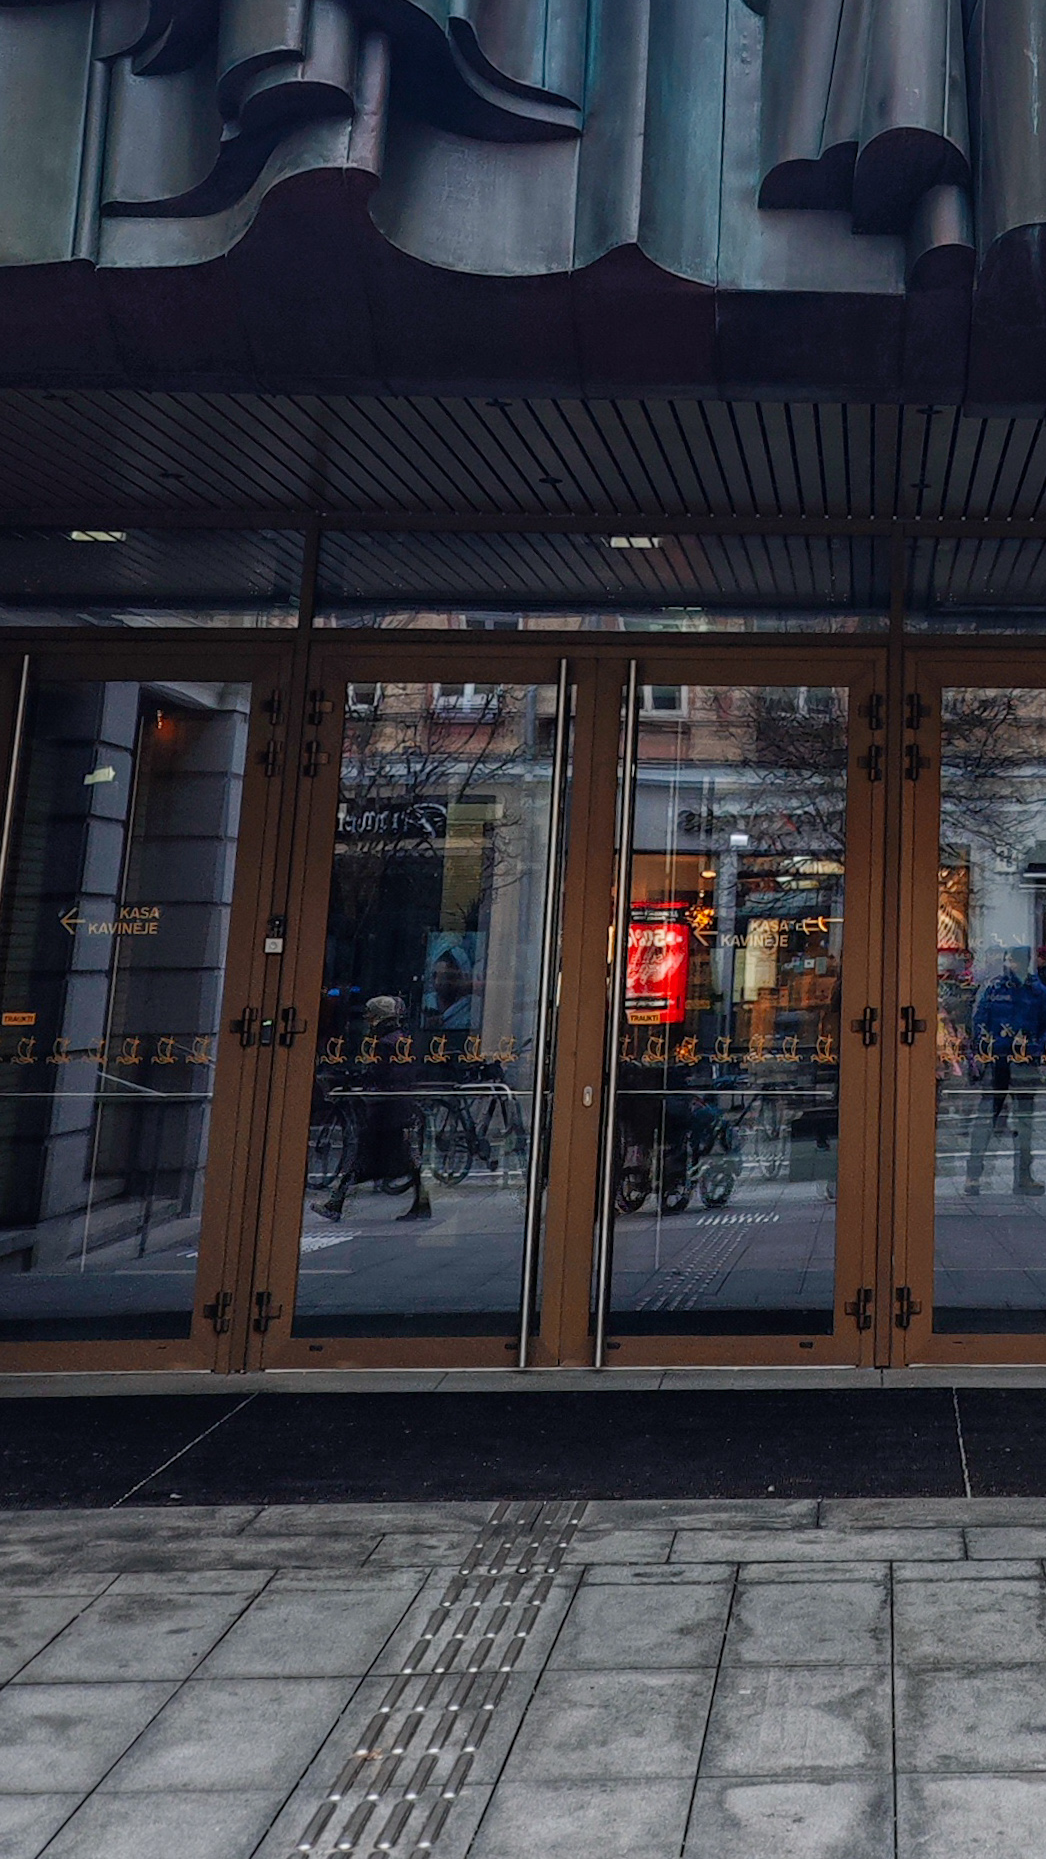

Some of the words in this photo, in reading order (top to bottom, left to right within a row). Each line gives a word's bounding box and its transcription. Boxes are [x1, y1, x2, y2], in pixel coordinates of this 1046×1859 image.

[120, 906, 160, 919] KASA
[88, 919, 159, 935] KAVINĖJE
[750, 920, 789, 932] KASA
